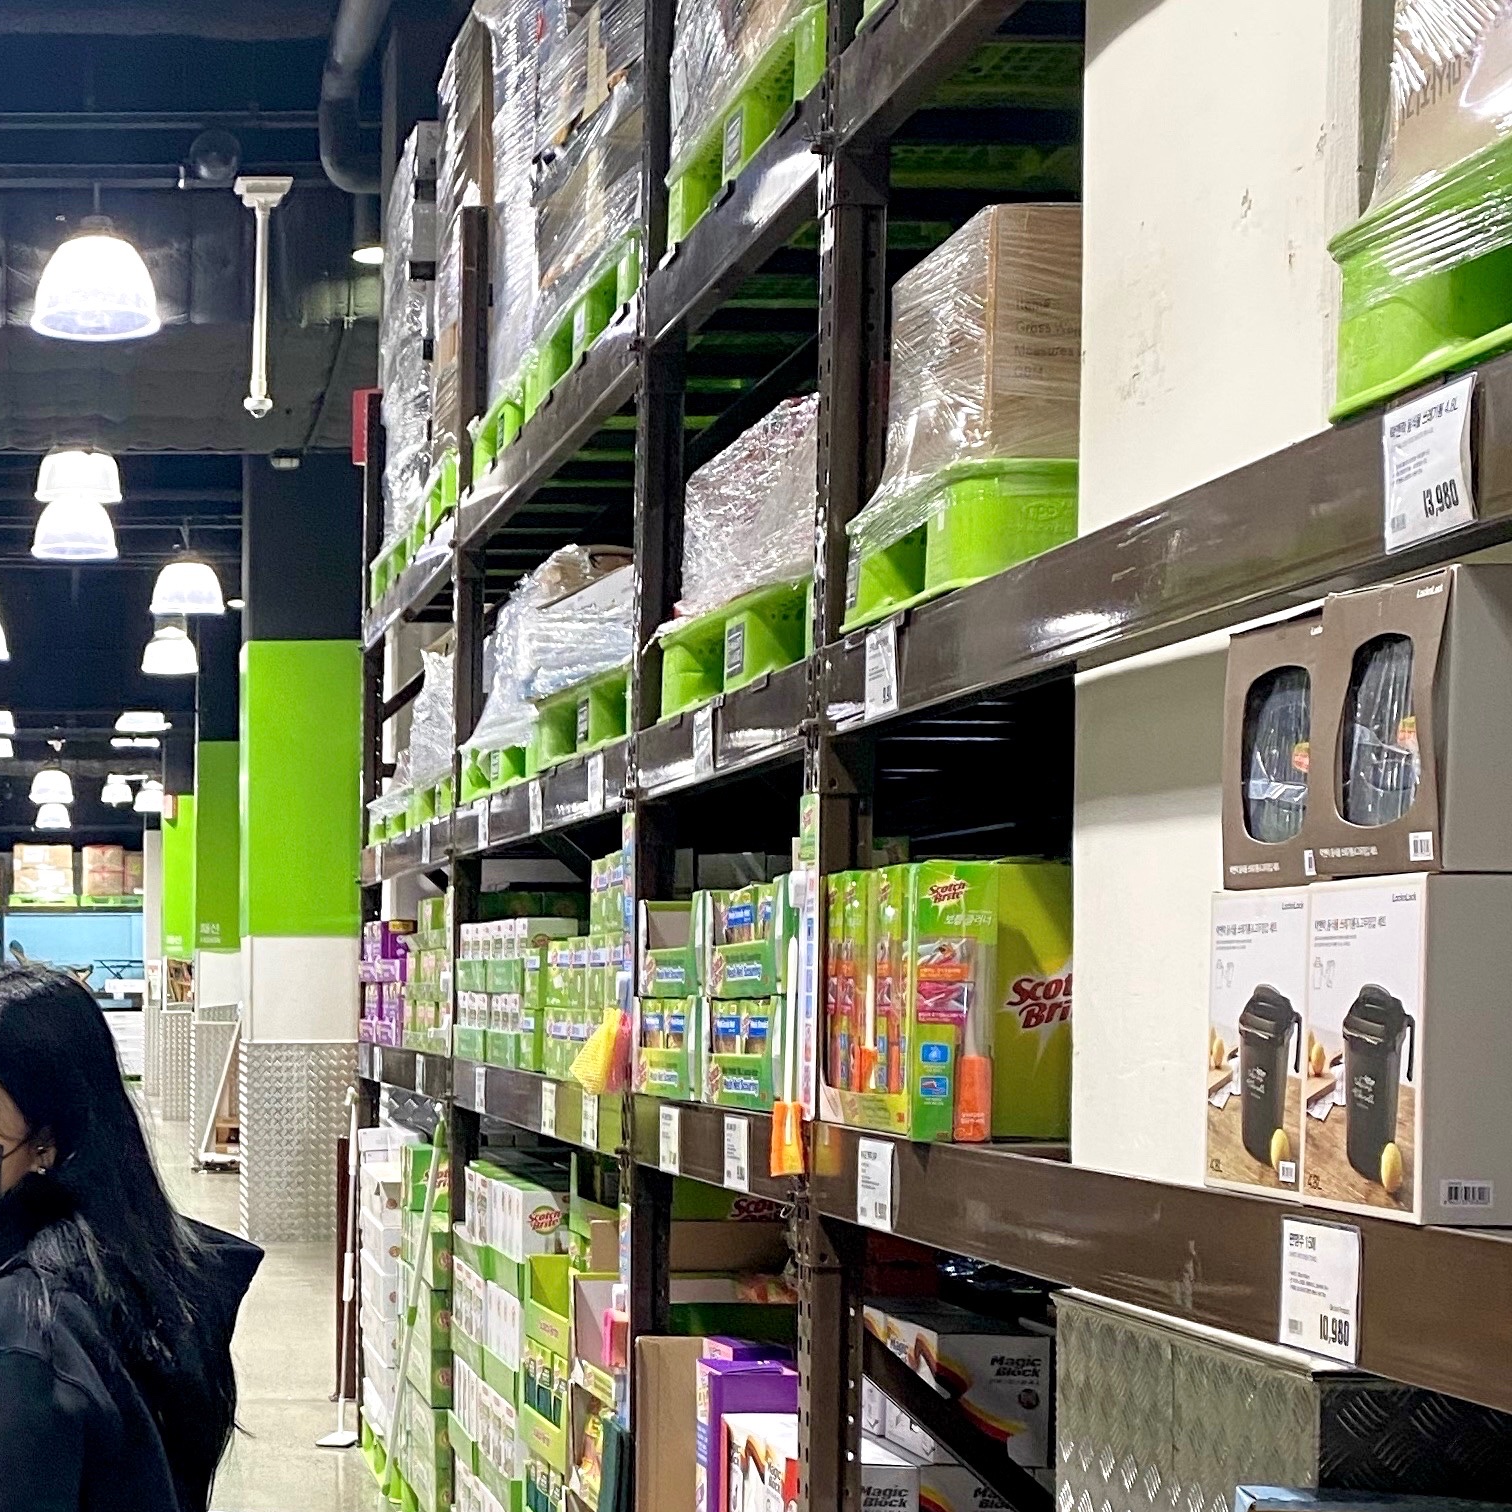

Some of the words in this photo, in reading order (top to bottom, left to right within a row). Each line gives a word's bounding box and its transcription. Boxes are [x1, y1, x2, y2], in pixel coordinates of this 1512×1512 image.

[1422, 478, 1459, 518] 13,980
[928, 880, 966, 895] Scotch
[933, 889, 964, 904] Brite
[1006, 976, 1073, 1006] Scot
[528, 1209, 562, 1222] Scotch
[1319, 1313, 1350, 1347] 10,980
[990, 1354, 1042, 1368] Magic
[994, 1366, 1041, 1378] Block
[860, 1484, 909, 1498] Magic
[863, 1496, 908, 1509] Block
